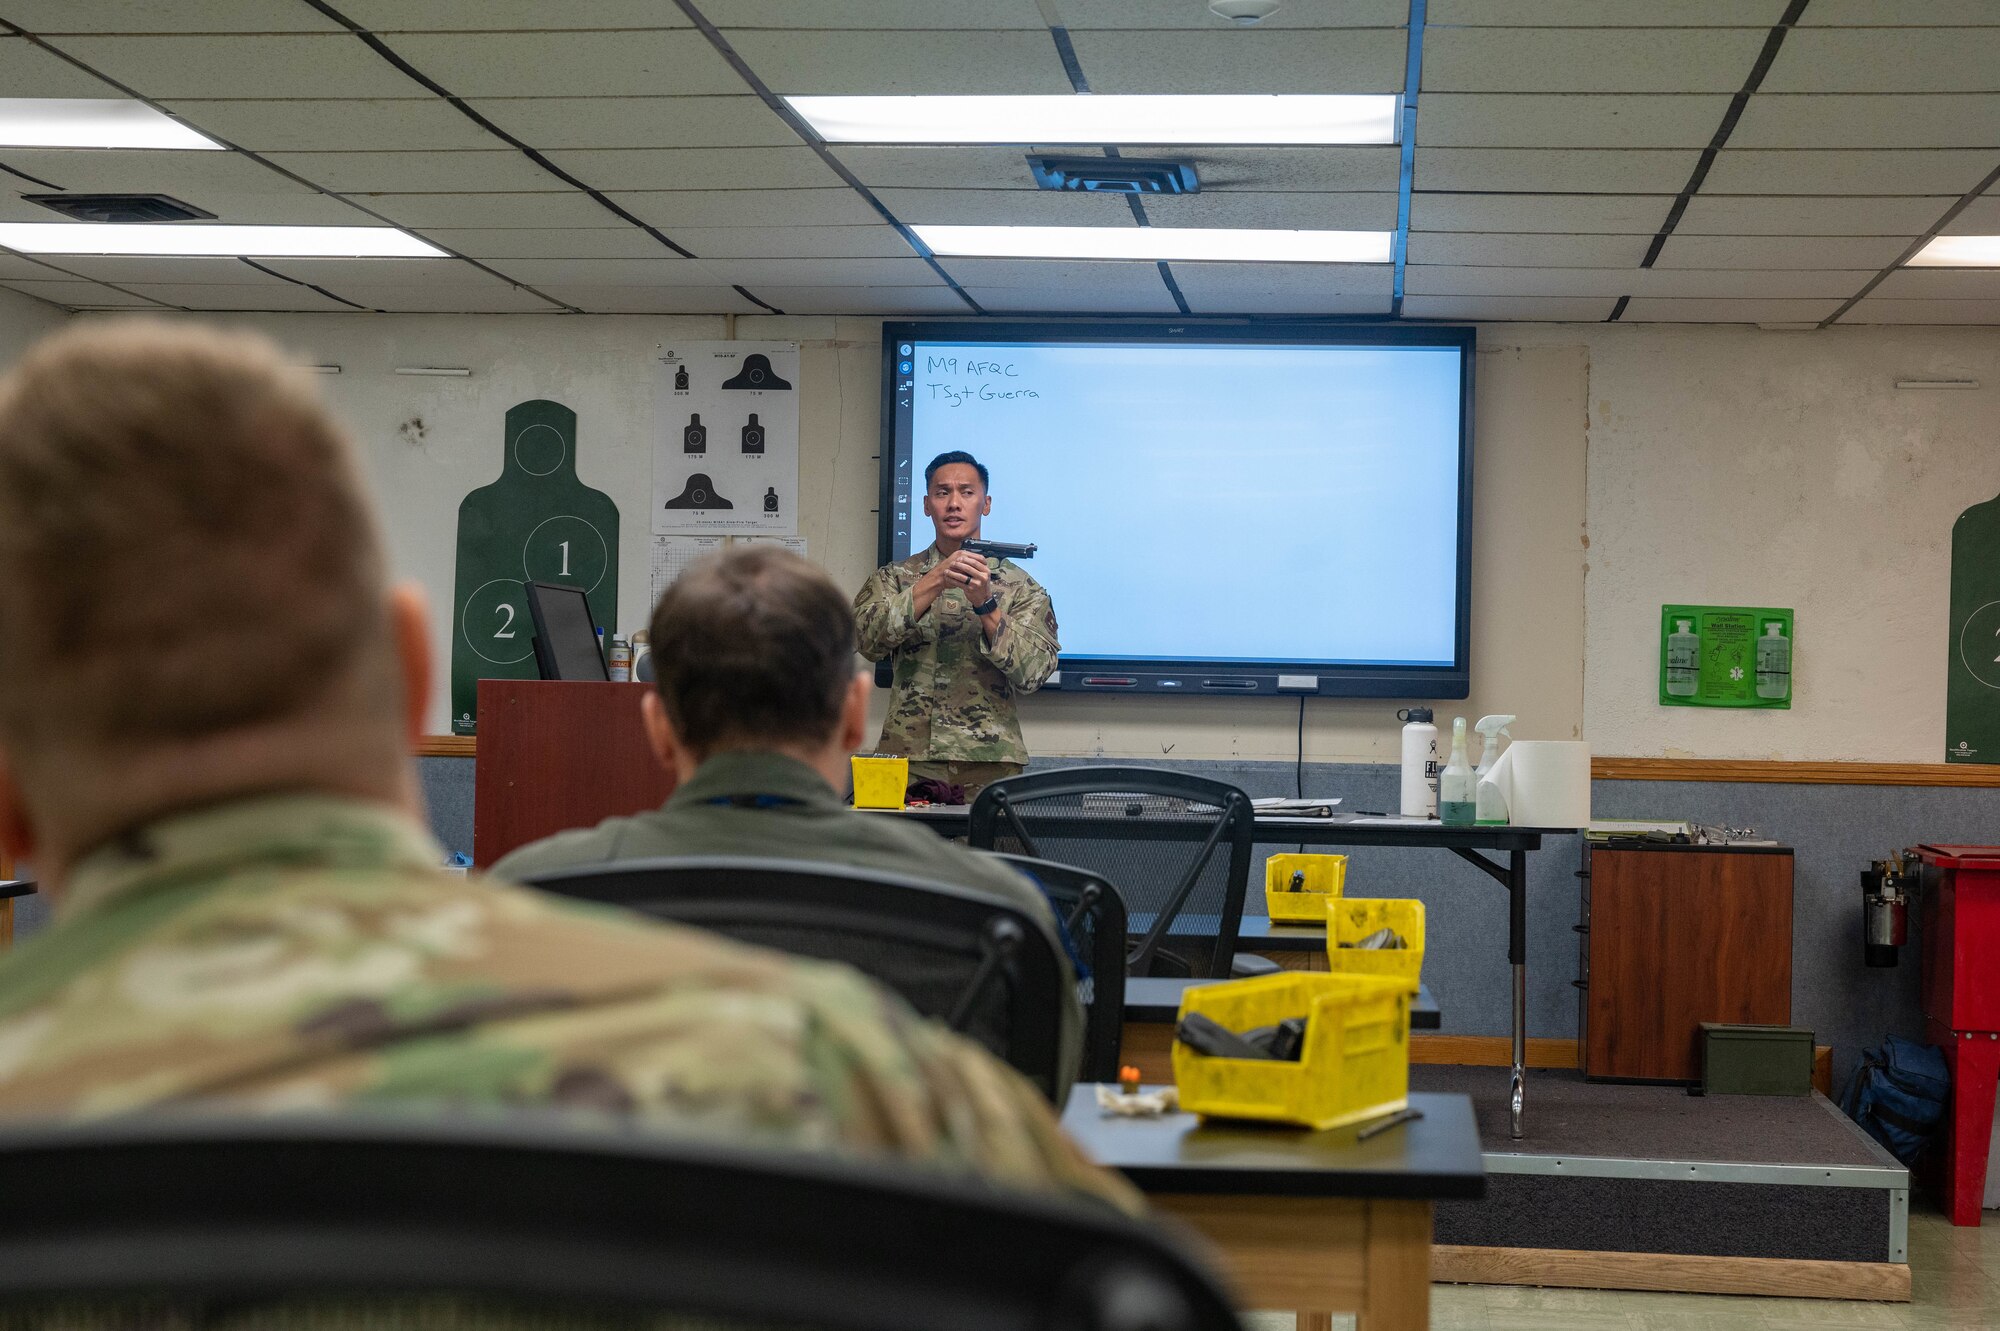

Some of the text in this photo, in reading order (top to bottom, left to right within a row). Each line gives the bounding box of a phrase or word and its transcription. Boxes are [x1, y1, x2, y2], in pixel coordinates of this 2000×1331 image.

[927, 355, 1019, 377] M9 AFQC
[979, 383, 1040, 401] Guerra
[558, 540, 572, 576] 1
[493, 603, 516, 639] 2
